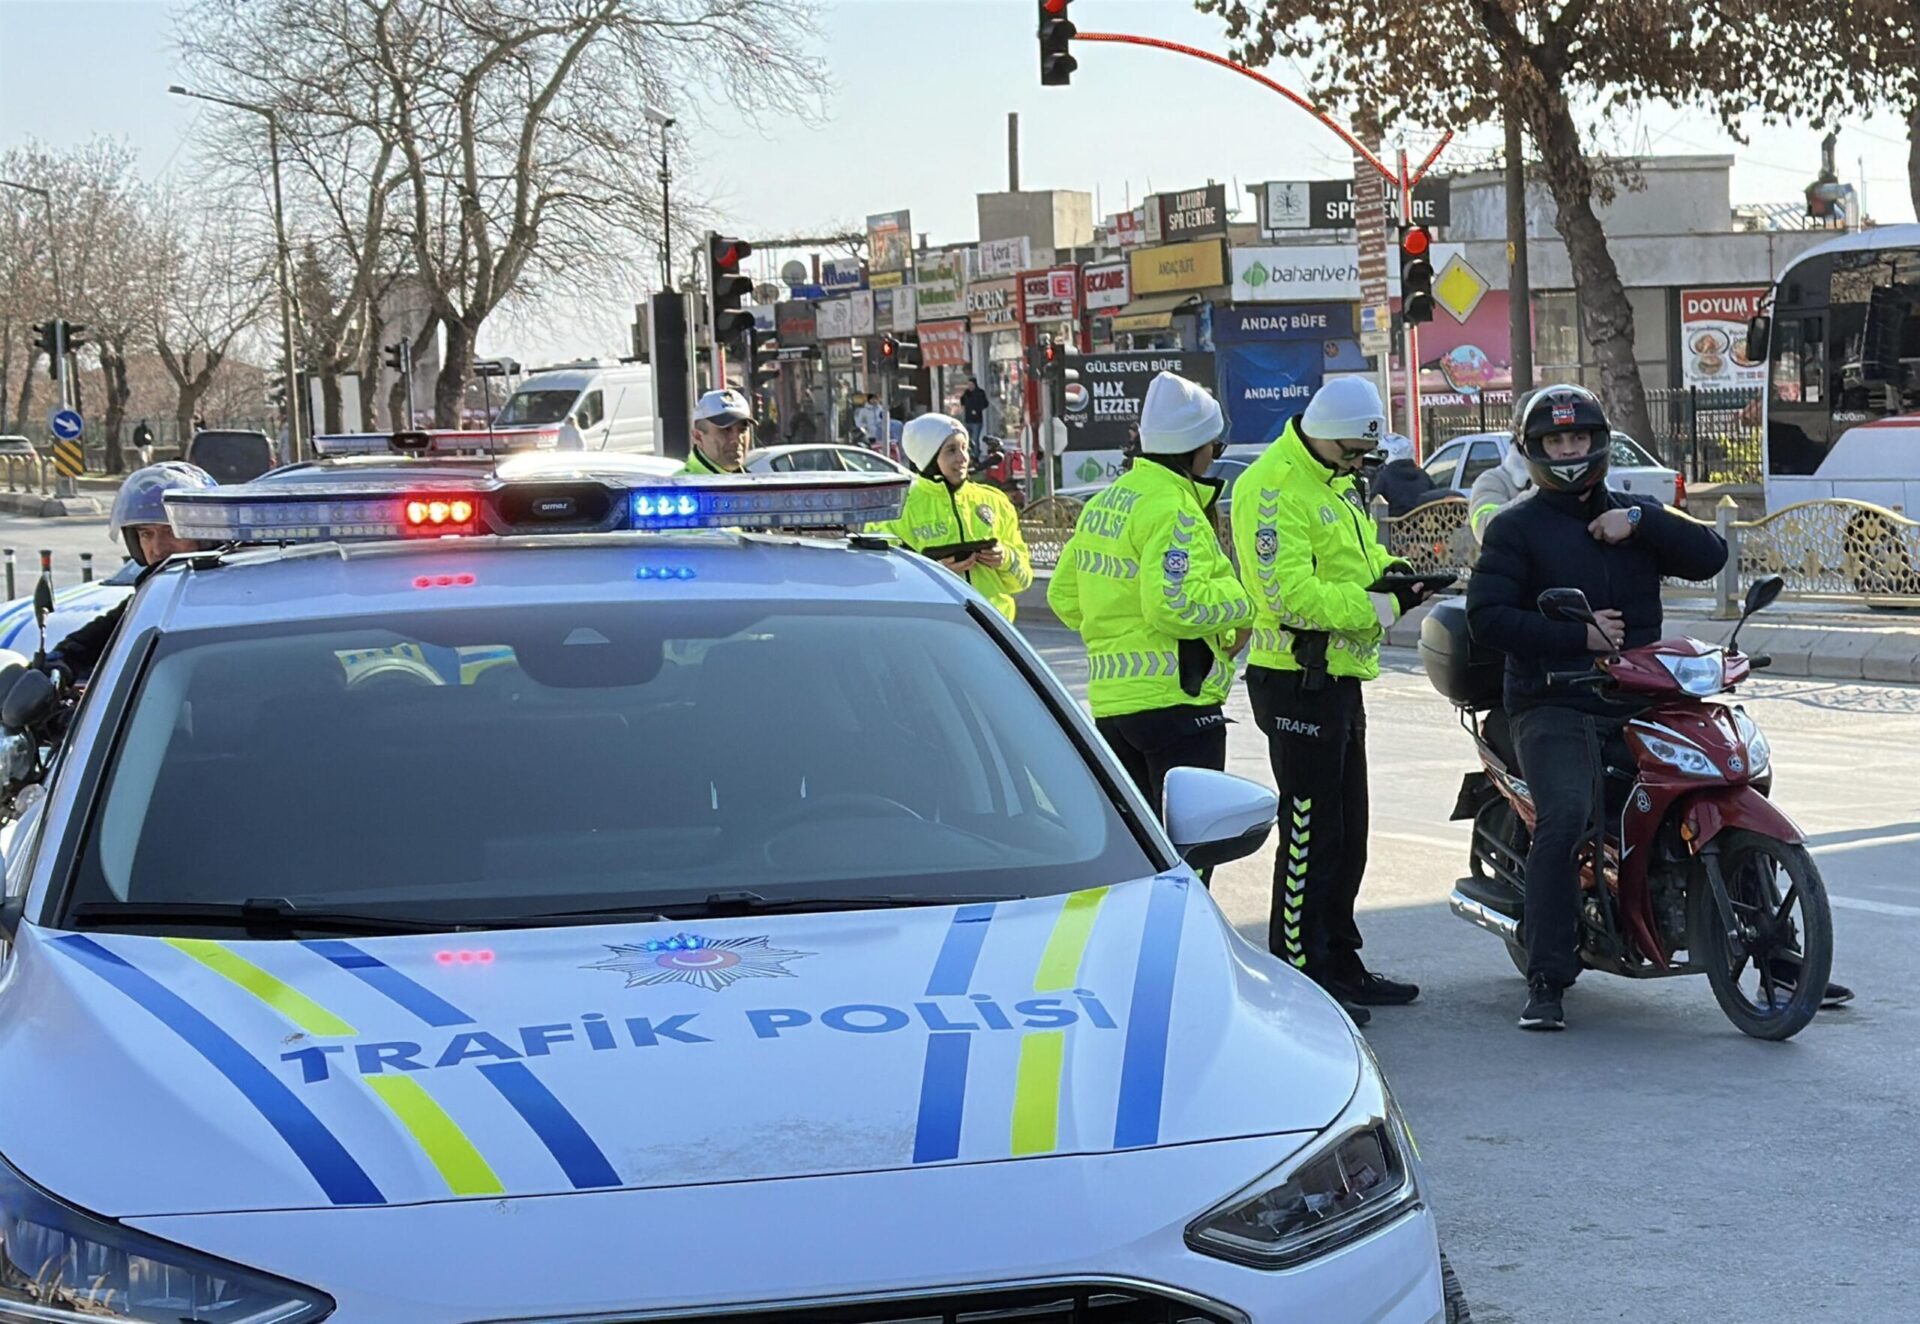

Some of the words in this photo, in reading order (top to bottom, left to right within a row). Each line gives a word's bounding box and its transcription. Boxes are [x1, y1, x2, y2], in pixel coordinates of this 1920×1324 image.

[1168, 211, 1185, 231] SPA
[1185, 206, 1216, 229] CENTRE
[1086, 269, 1125, 293] ECZANE
[1688, 297, 1748, 314] DOYUM
[1241, 316, 1288, 331] ANDAÇ
[1291, 313, 1327, 328] BÜFE
[1085, 360, 1148, 373] GÜLSEVEN
[1151, 358, 1182, 372] BÜFE
[1092, 381, 1125, 398] MAX
[1244, 387, 1281, 401] ANDAÇ
[1282, 384, 1310, 398] BÜFE
[1094, 398, 1140, 414] LEZZET
[280, 1012, 715, 1084] TRAFİK
[745, 988, 1118, 1039] POLİSİ
